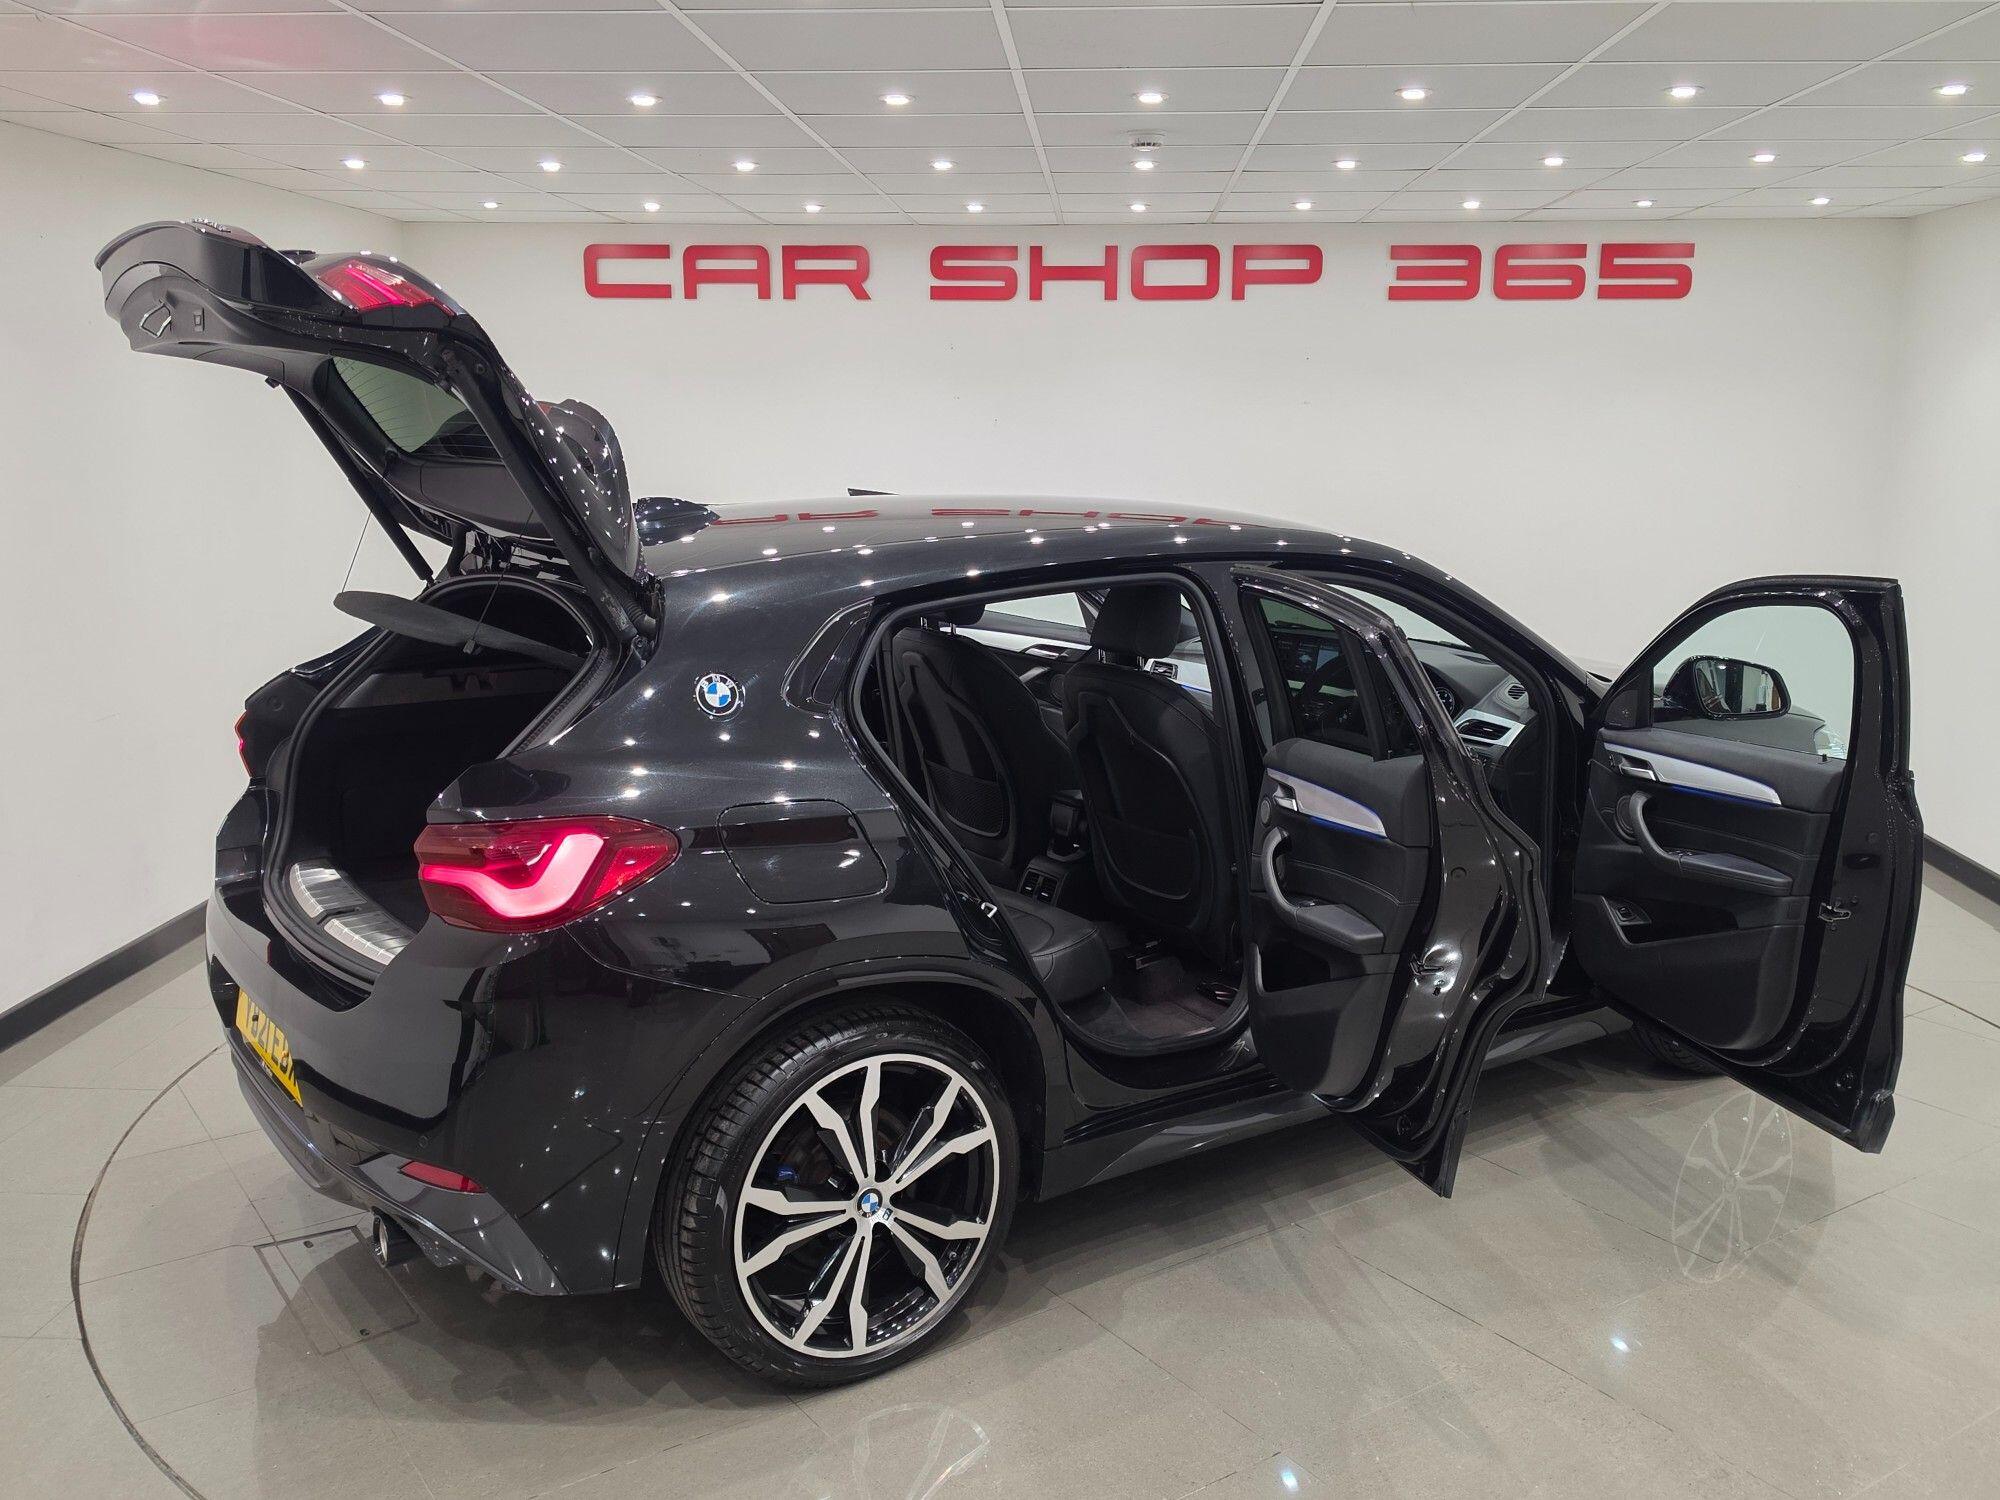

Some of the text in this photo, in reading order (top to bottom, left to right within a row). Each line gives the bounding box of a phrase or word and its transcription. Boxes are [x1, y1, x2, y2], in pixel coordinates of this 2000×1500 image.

[583, 242, 1696, 302] CAR SHOP 365
